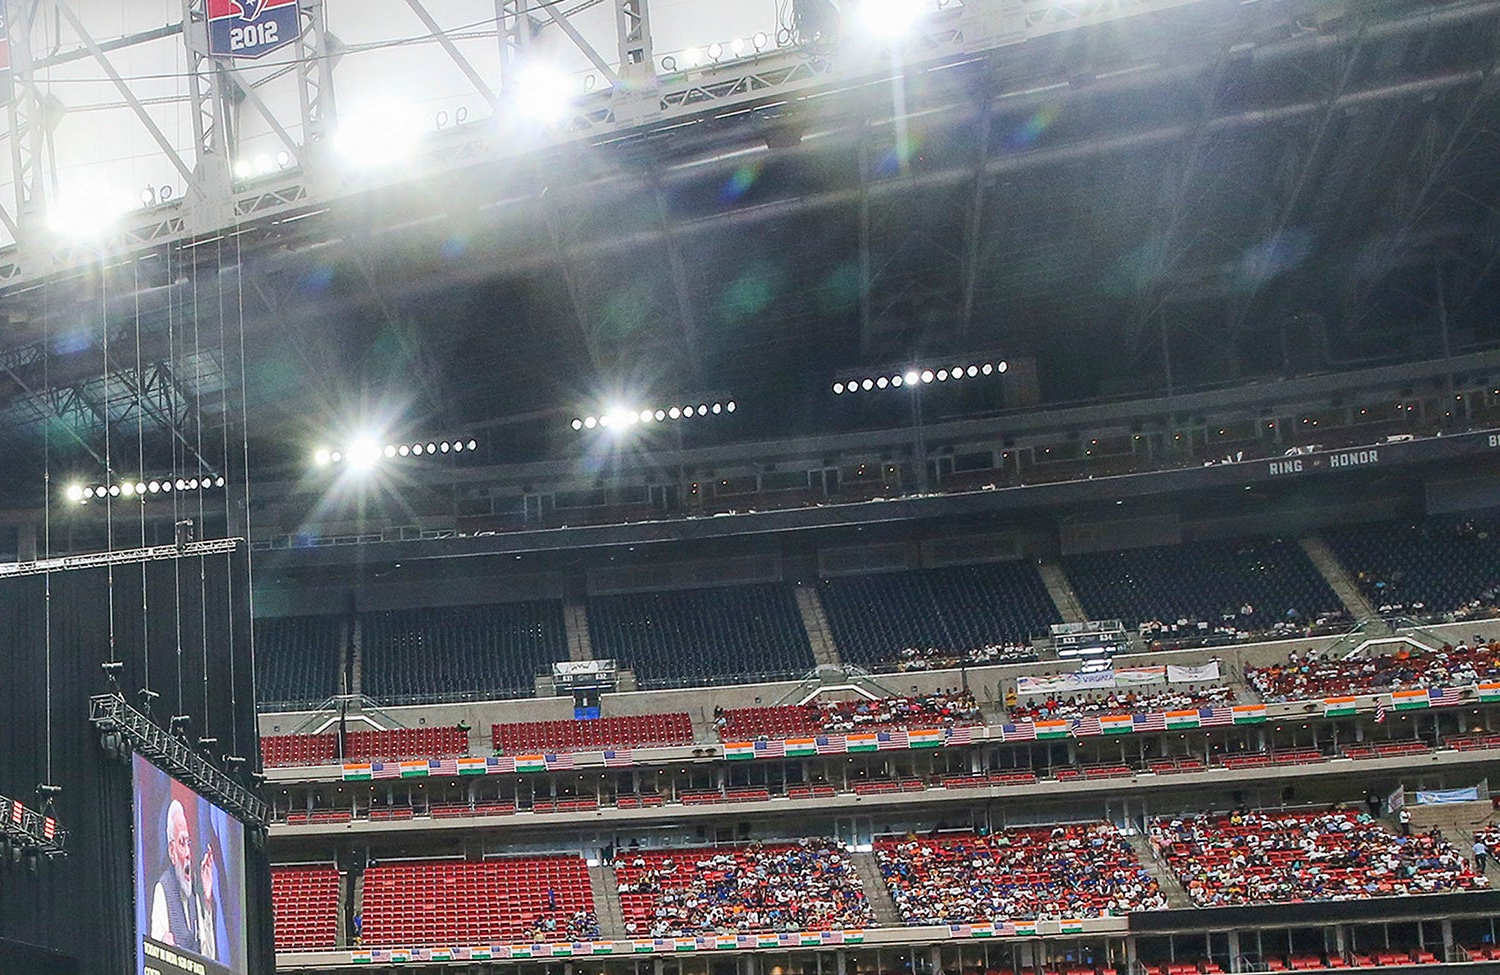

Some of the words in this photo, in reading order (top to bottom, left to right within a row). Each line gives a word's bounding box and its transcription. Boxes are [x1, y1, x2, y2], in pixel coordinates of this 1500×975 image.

[230, 21, 279, 51] 2012
[1269, 459, 1303, 475] RING
[1330, 450, 1378, 467] HONOR
